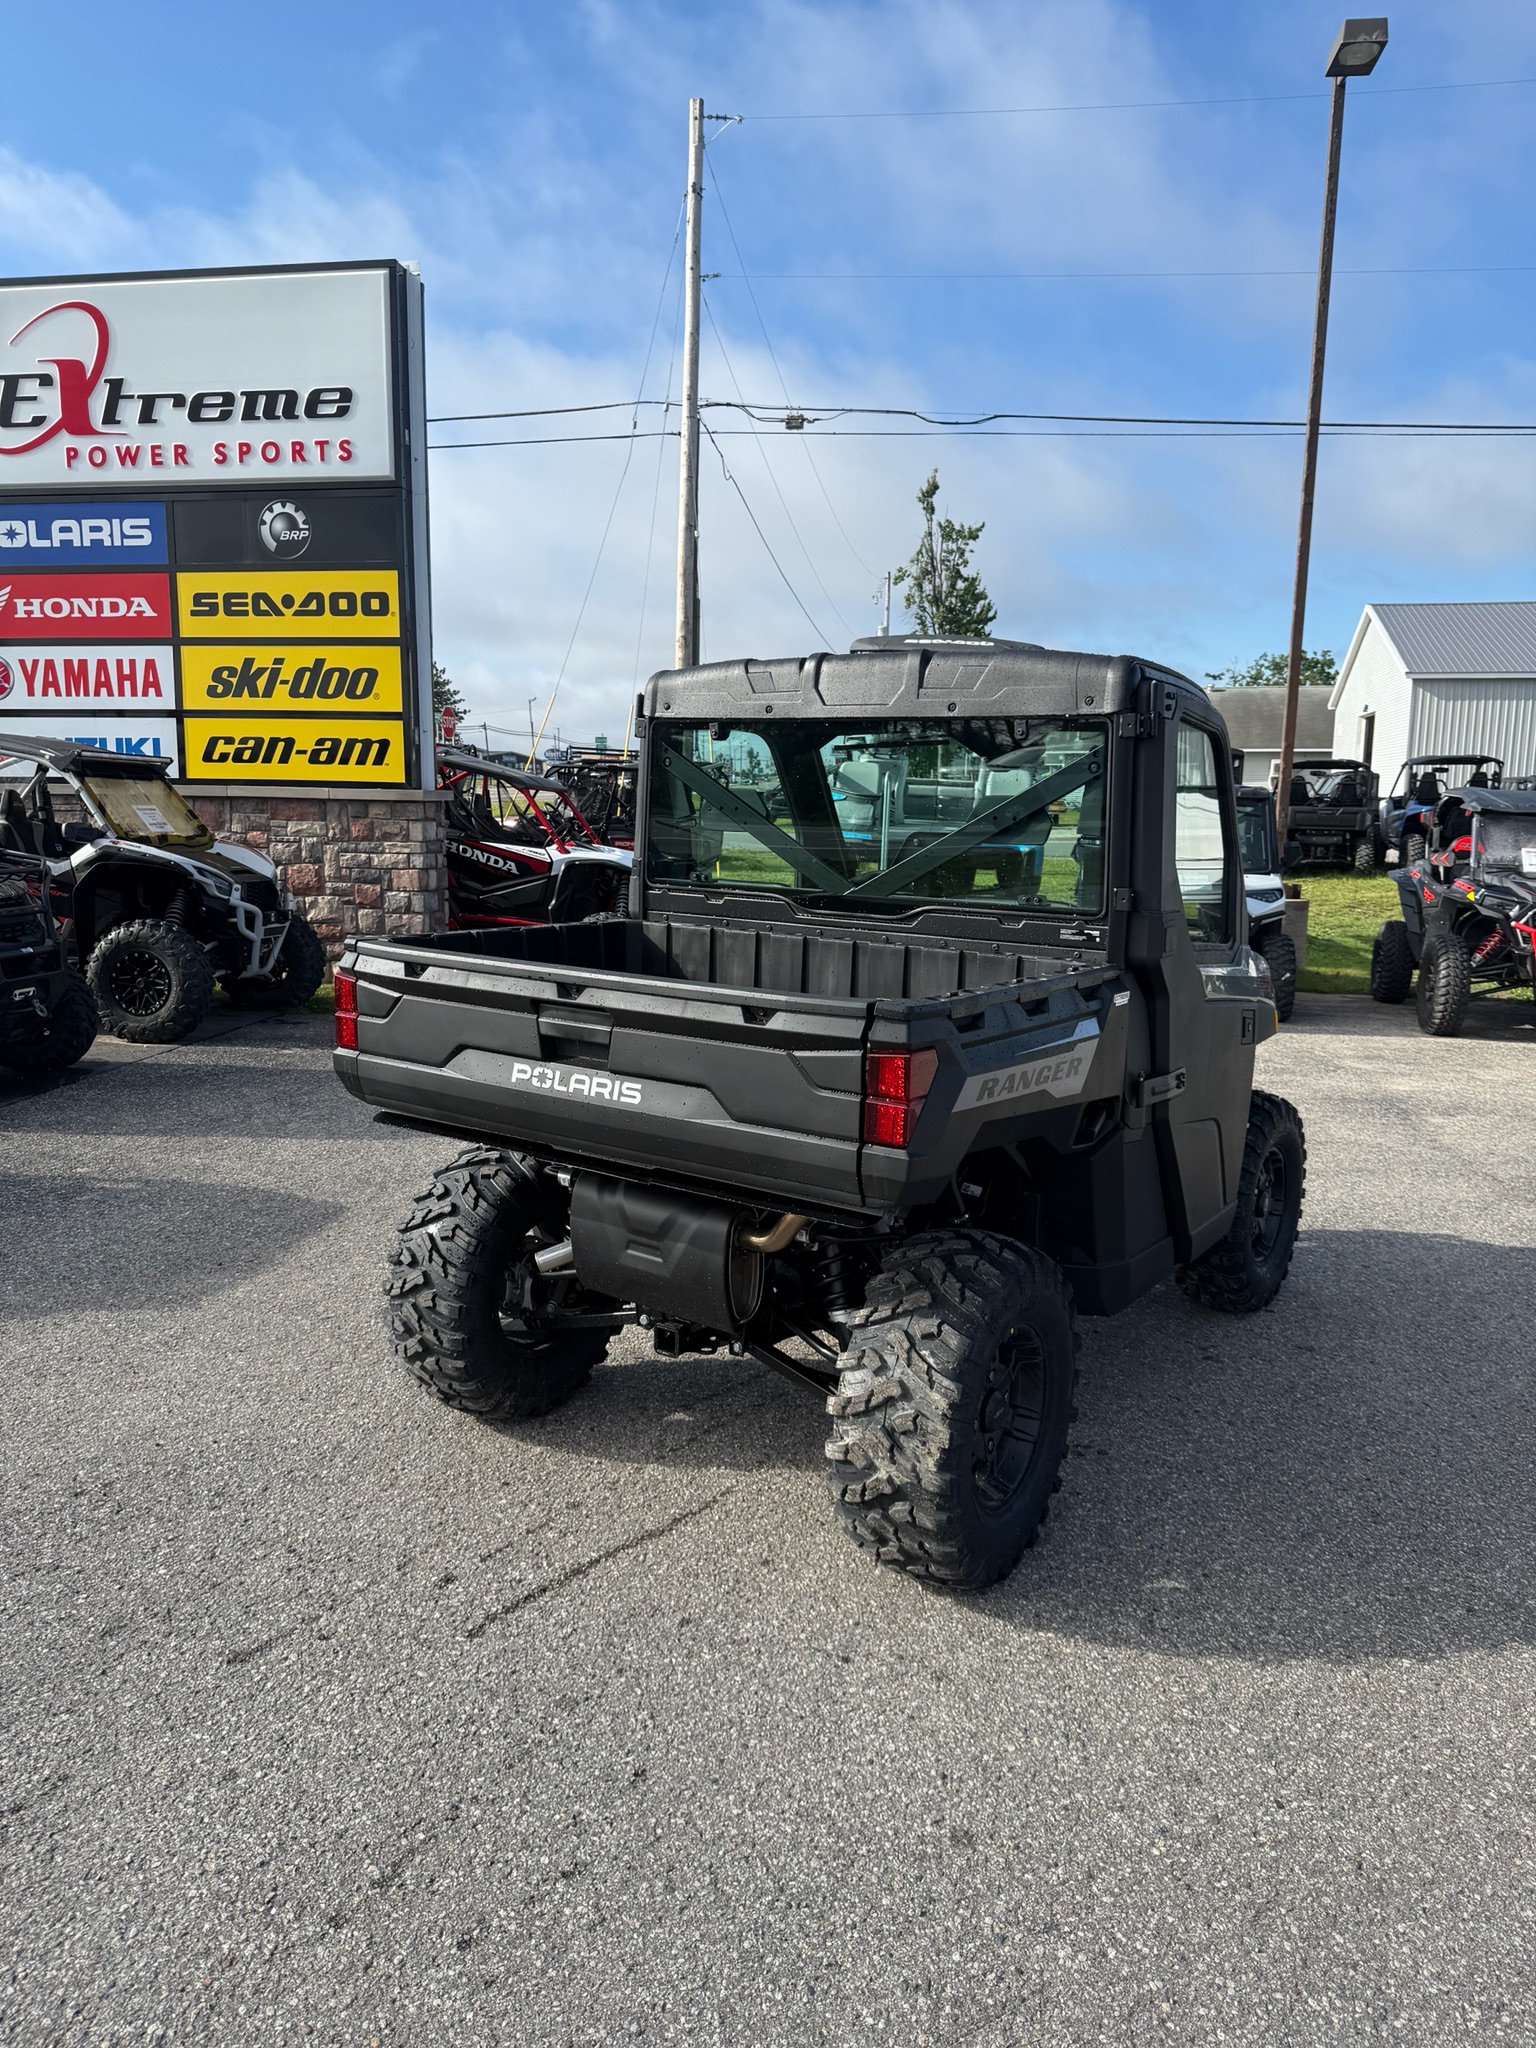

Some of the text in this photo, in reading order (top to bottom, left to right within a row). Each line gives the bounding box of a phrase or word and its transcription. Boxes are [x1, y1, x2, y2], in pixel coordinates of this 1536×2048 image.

[65, 438, 353, 468] POWER SPORTS
[0, 518, 152, 548] OLARIS
[280, 530, 309, 541] BRP
[13, 597, 158, 618] HONDA
[18, 658, 163, 698] YAMAHA
[205, 657, 379, 700] ski-doo
[443, 716, 455, 728] STOP
[201, 736, 391, 767] can-am
[444, 840, 520, 875] HONDA
[614, 841, 636, 849] PION
[511, 1062, 642, 1105] POLARIS
[976, 1057, 1083, 1102] RANGER
